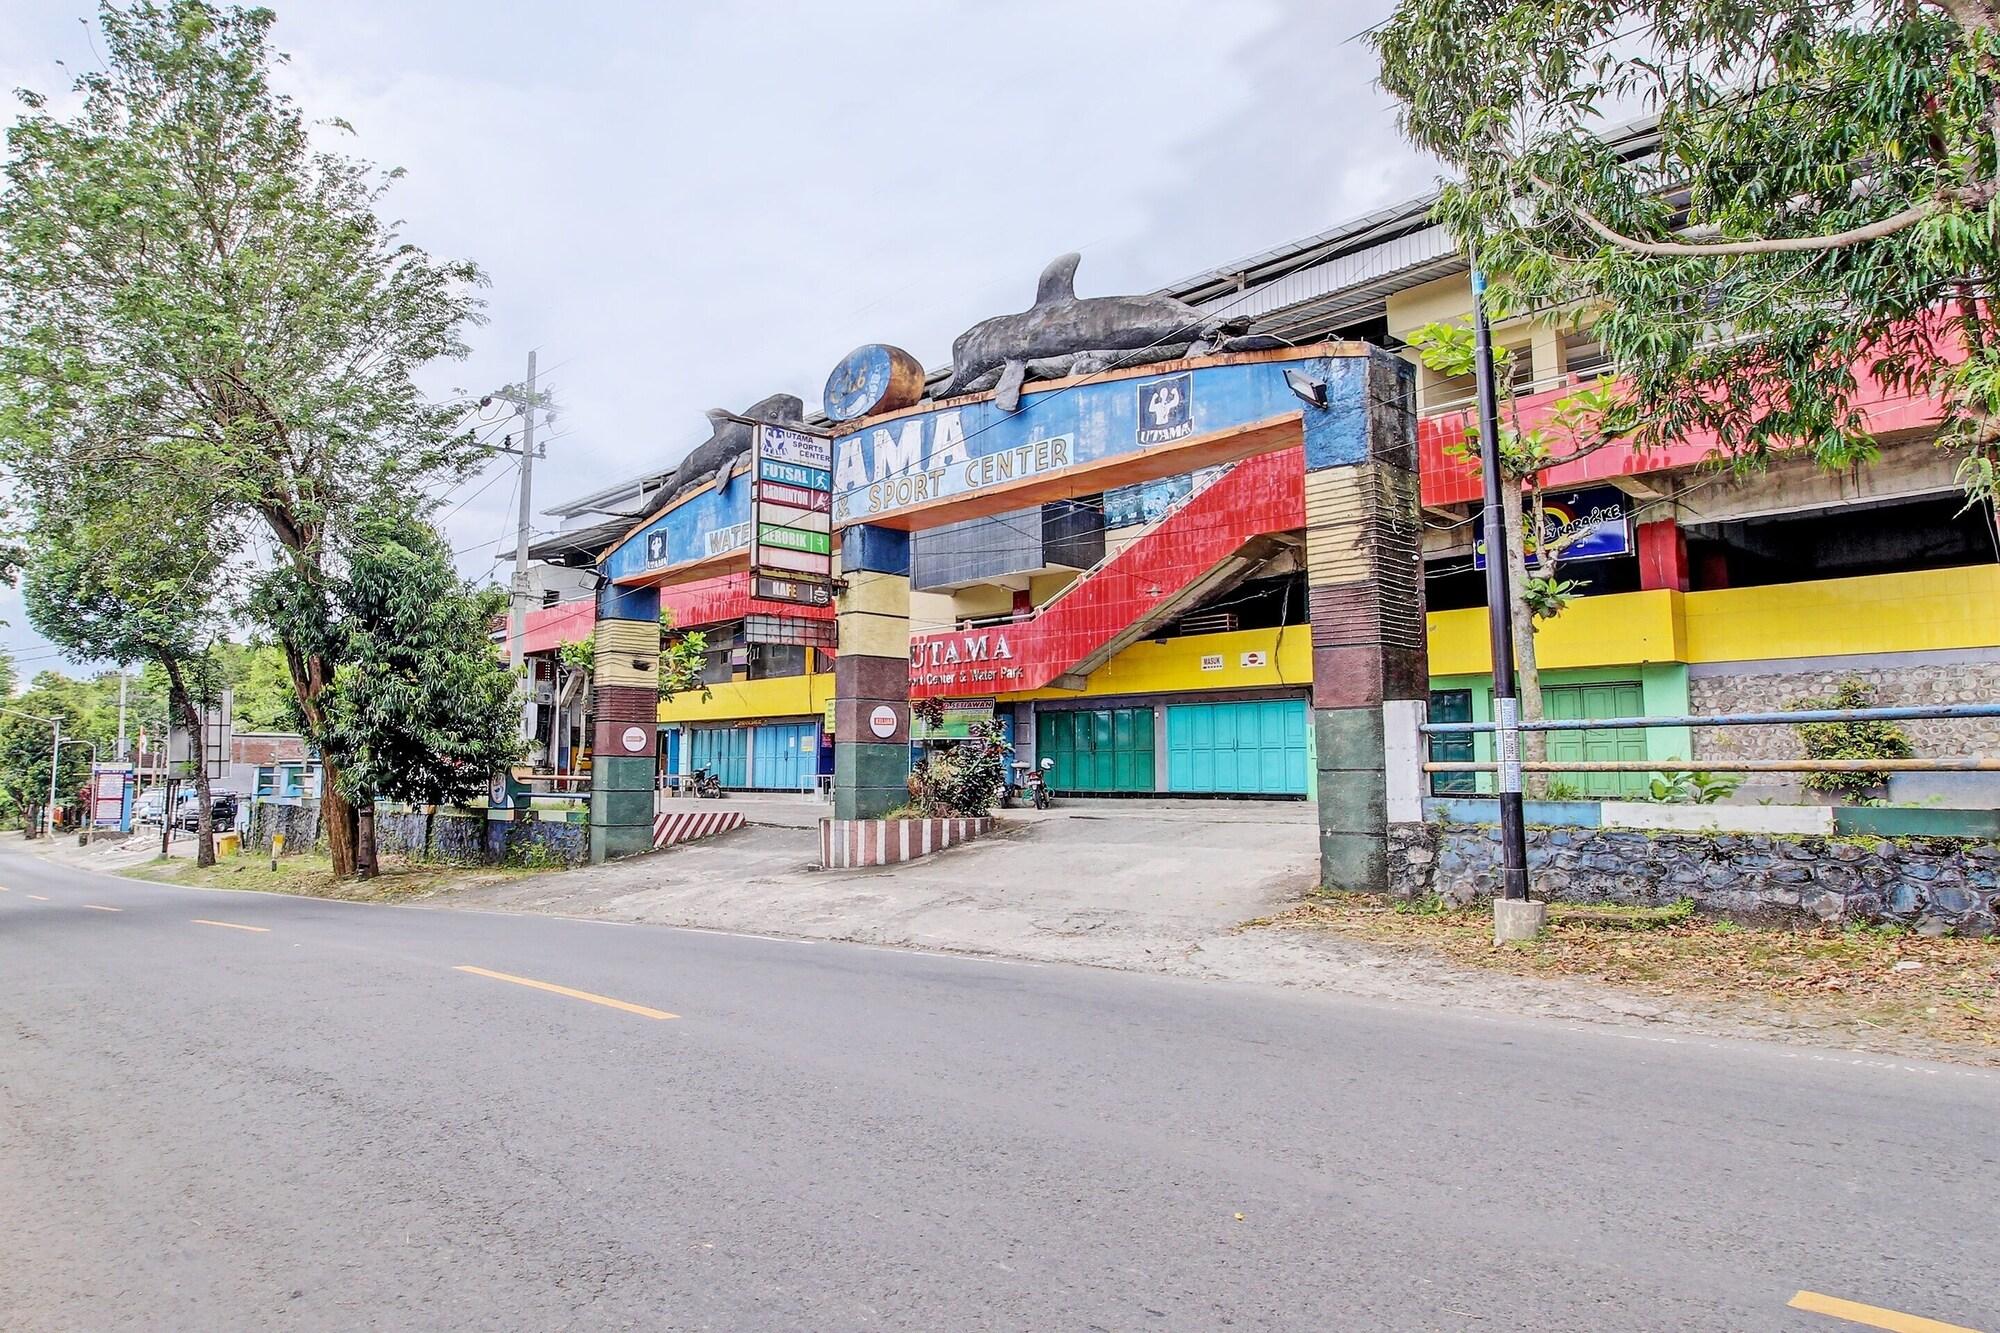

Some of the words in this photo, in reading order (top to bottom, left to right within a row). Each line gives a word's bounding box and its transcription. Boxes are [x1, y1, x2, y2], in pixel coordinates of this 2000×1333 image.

[786, 431, 814, 444] UTAMA
[1140, 422, 1191, 443] UTAMA
[792, 441, 824, 453] SPORTS
[799, 450, 831, 462] CENTER
[762, 463, 809, 484] FUTSAL
[835, 494, 850, 521] &
[868, 469, 946, 513] SPORT
[965, 438, 1068, 488] CENTER
[762, 527, 807, 548] AEROBIK
[772, 581, 798, 598] KAFE
[909, 633, 1013, 669] UTAMA
[1203, 656, 1221, 665] MASUK
[926, 672, 956, 685] Center
[959, 672, 967, 683] &
[971, 669, 998, 682] Water
[1000, 667, 1024, 680] Park
